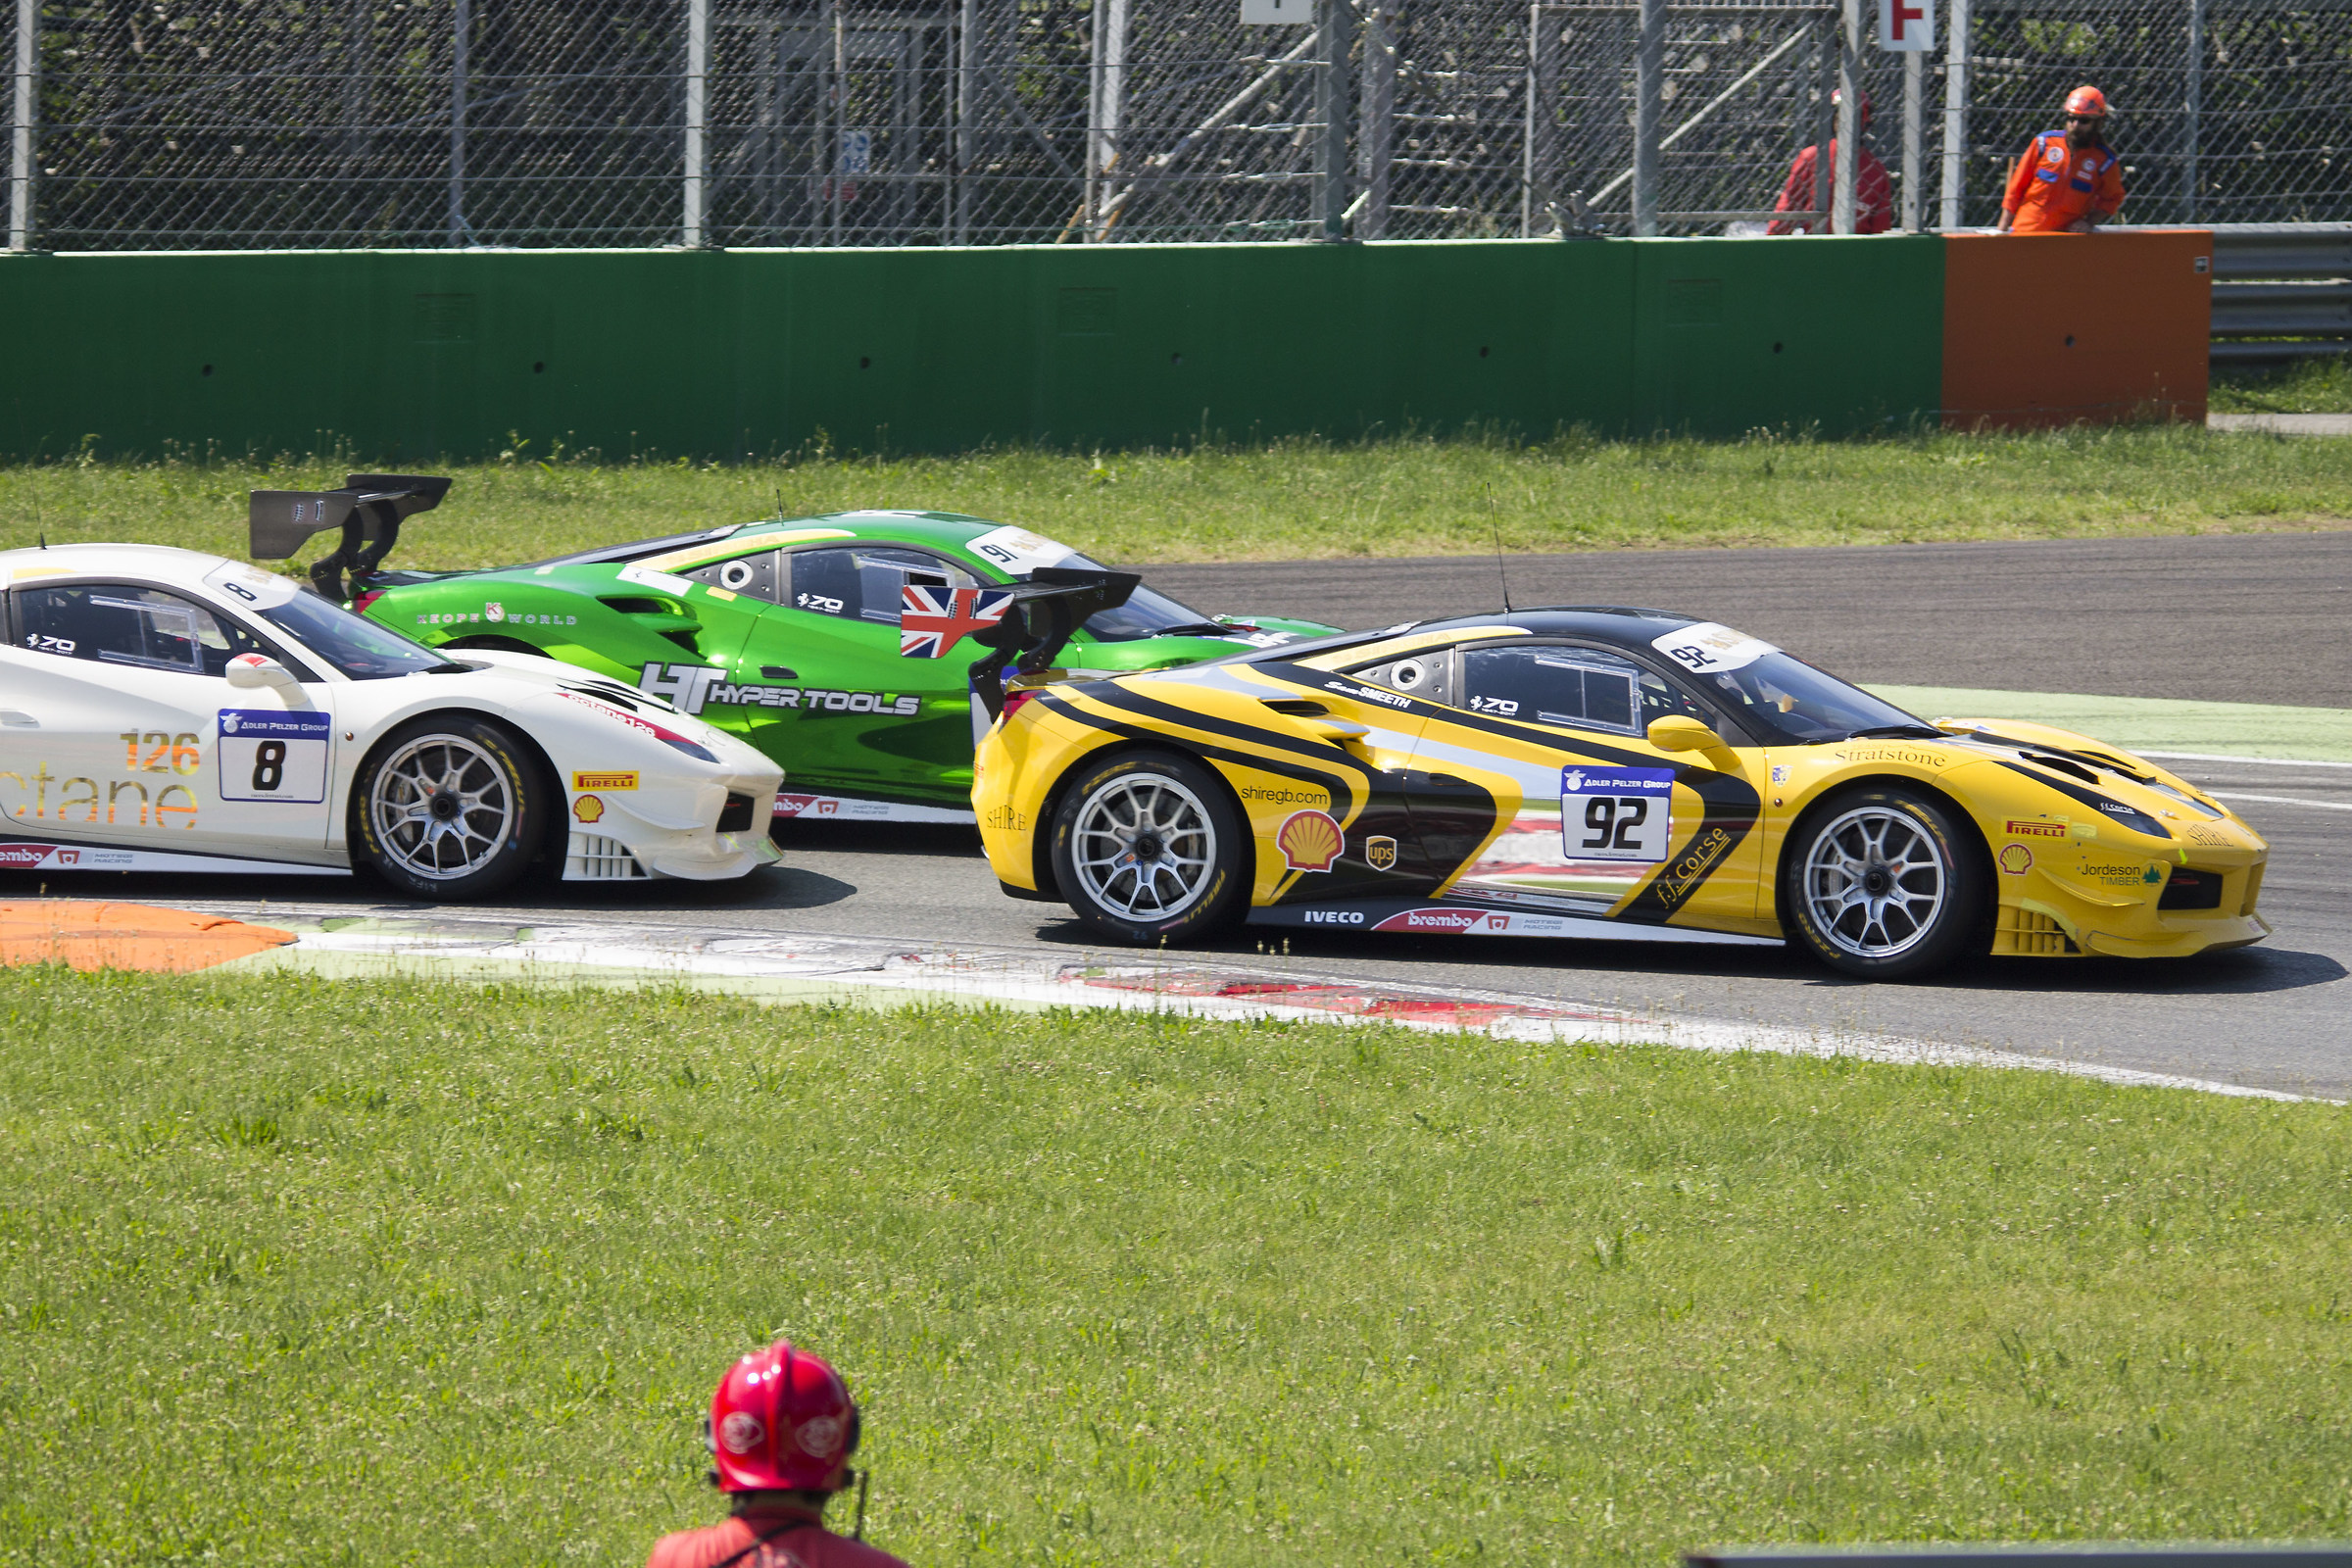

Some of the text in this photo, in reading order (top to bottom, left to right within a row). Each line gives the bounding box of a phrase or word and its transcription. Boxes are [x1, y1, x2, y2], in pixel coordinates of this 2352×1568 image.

[1892, 0, 1923, 40] F
[223, 582, 257, 601] 8
[808, 595, 844, 611] 70
[416, 613, 577, 625] KEOPE WORLD
[39, 635, 75, 652] 70
[1670, 646, 1719, 668] 92
[639, 662, 728, 715] HT
[1358, 686, 1412, 709] SMEETH
[708, 683, 921, 716] HYPER TOOLS
[1482, 697, 1519, 712] 70
[567, 695, 656, 738] octane126
[241, 721, 268, 730] ADLER
[270, 722, 299, 731] PELZER
[120, 732, 200, 776] 126
[1835, 750, 1945, 767] Stratstone
[252, 741, 286, 791] 8
[578, 775, 633, 787] PIRELLI
[1612, 779, 1642, 788] PELZER
[1642, 780, 1671, 789] GROUP
[1241, 785, 1328, 805] shiregb.com
[987, 805, 1027, 831] SHIRE
[1582, 797, 1647, 850] 92
[2006, 820, 2066, 837] PIRELLI
[2187, 824, 2234, 847] SHIRE
[1369, 846, 1393, 864] ups
[2082, 863, 2140, 875] Jordeson
[2099, 876, 2140, 886] TIMBER
[1304, 910, 1364, 924] IVECO
[1407, 912, 1473, 927] brembo
